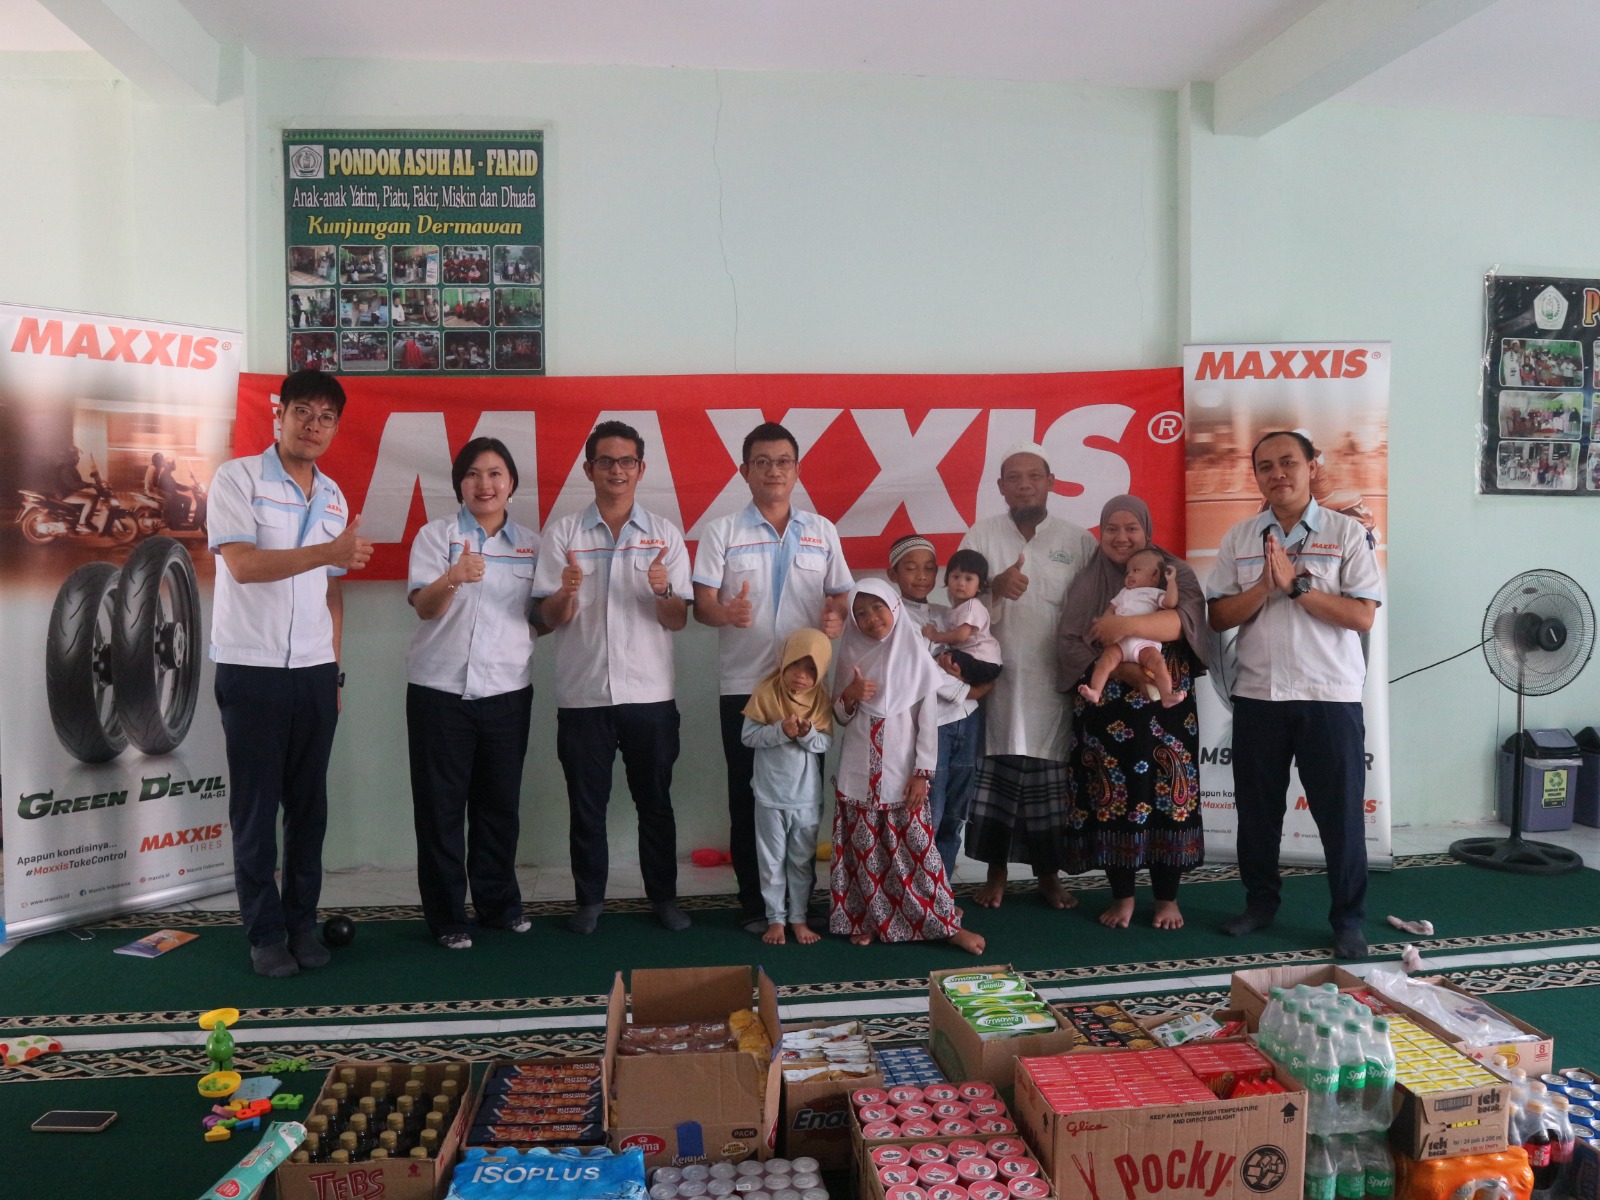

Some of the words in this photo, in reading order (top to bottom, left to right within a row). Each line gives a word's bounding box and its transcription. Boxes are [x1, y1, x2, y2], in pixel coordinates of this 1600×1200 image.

[329, 148, 401, 176] PONDOK
[403, 148, 451, 176] ASUH
[453, 149, 475, 176] AL
[486, 149, 538, 177] FARID
[292, 185, 347, 208] Anak-anak
[350, 185, 380, 211] Yatim,
[383, 185, 410, 211] Piatu,
[413, 185, 439, 211] Fakir,
[442, 185, 477, 208] Miskin
[480, 185, 498, 208] dan
[501, 185, 536, 208] Dhuafa
[308, 215, 411, 240] Kunjungan
[417, 214, 522, 235] Dermawan
[11, 317, 219, 370] MAXXIS
[1195, 348, 1368, 381] MAXXIS
[1311, 542, 1339, 550] MAXXIS
[17, 788, 129, 820] GREEN
[138, 772, 226, 802] DEVIL
[200, 790, 226, 801] MA-G1
[1200, 790, 1221, 799] apun
[139, 823, 223, 853] MAXXIS
[189, 840, 222, 854] TIRES
[17, 851, 55, 867] Apapun
[25, 850, 127, 877] #MaxxisTakeControl
[1478, 1088, 1501, 1106] teh
[1185, 1110, 1201, 1118] FROM
[1217, 1105, 1259, 1114] TEMPERATURE
[1186, 1116, 1207, 1124] DIRECT
[1208, 1114, 1236, 1122] SUNLIGHT
[733, 1129, 756, 1137] PACK
[1066, 1120, 1108, 1137] Glico
[1428, 1136, 1448, 1151] teh
[472, 1165, 600, 1184] ISOPLUS
[309, 1168, 385, 1200] TEBS
